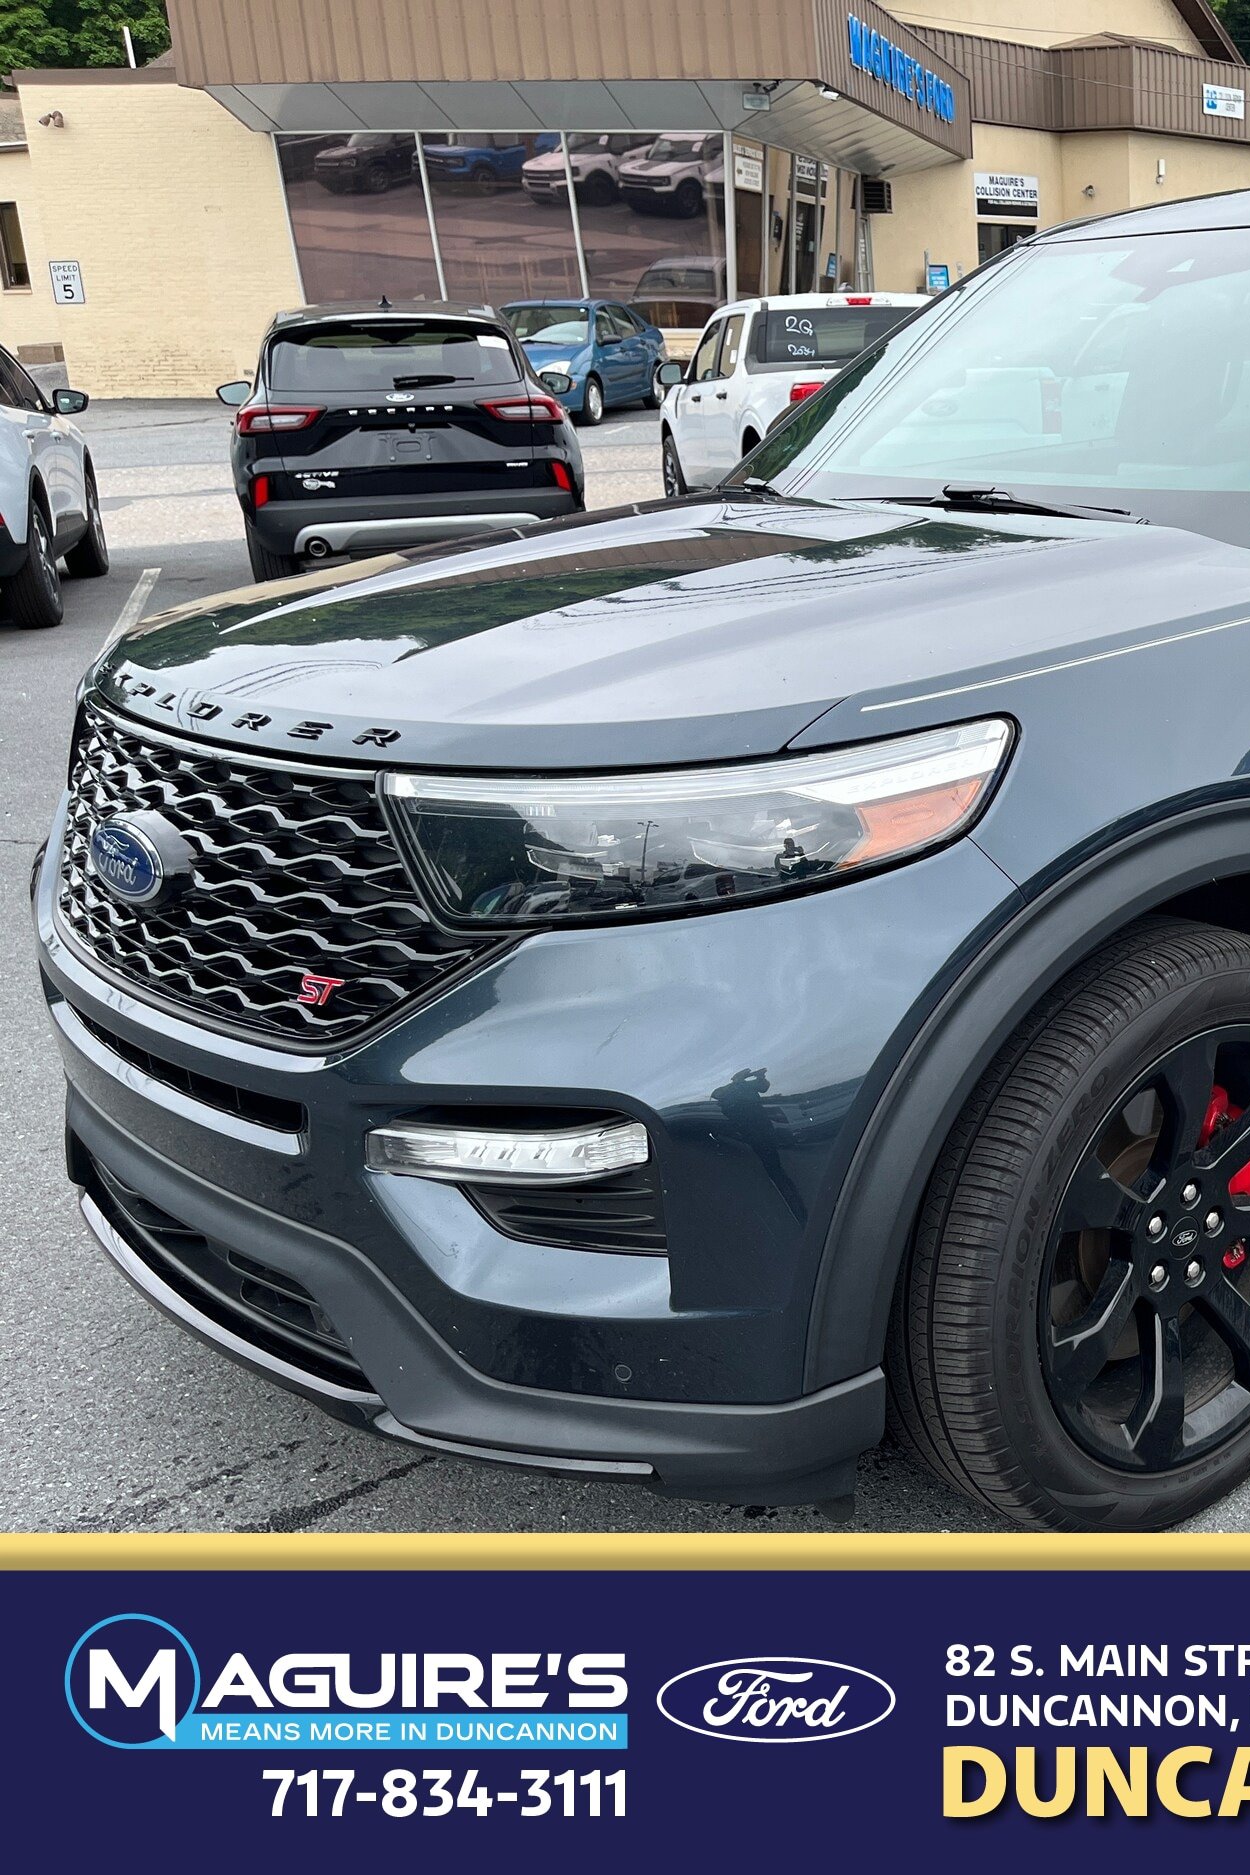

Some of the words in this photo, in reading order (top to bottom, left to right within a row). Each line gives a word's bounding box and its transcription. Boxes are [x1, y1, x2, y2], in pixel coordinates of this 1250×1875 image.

[926, 69, 955, 124] FORD
[975, 186, 1011, 197] COLLISION
[1012, 188, 1038, 199] CENTER
[988, 176, 1025, 187] MAGUIRE'S
[63, 284, 75, 299] 5
[297, 974, 345, 1006] ST
[1041, 1065, 1111, 1185] ZERO
